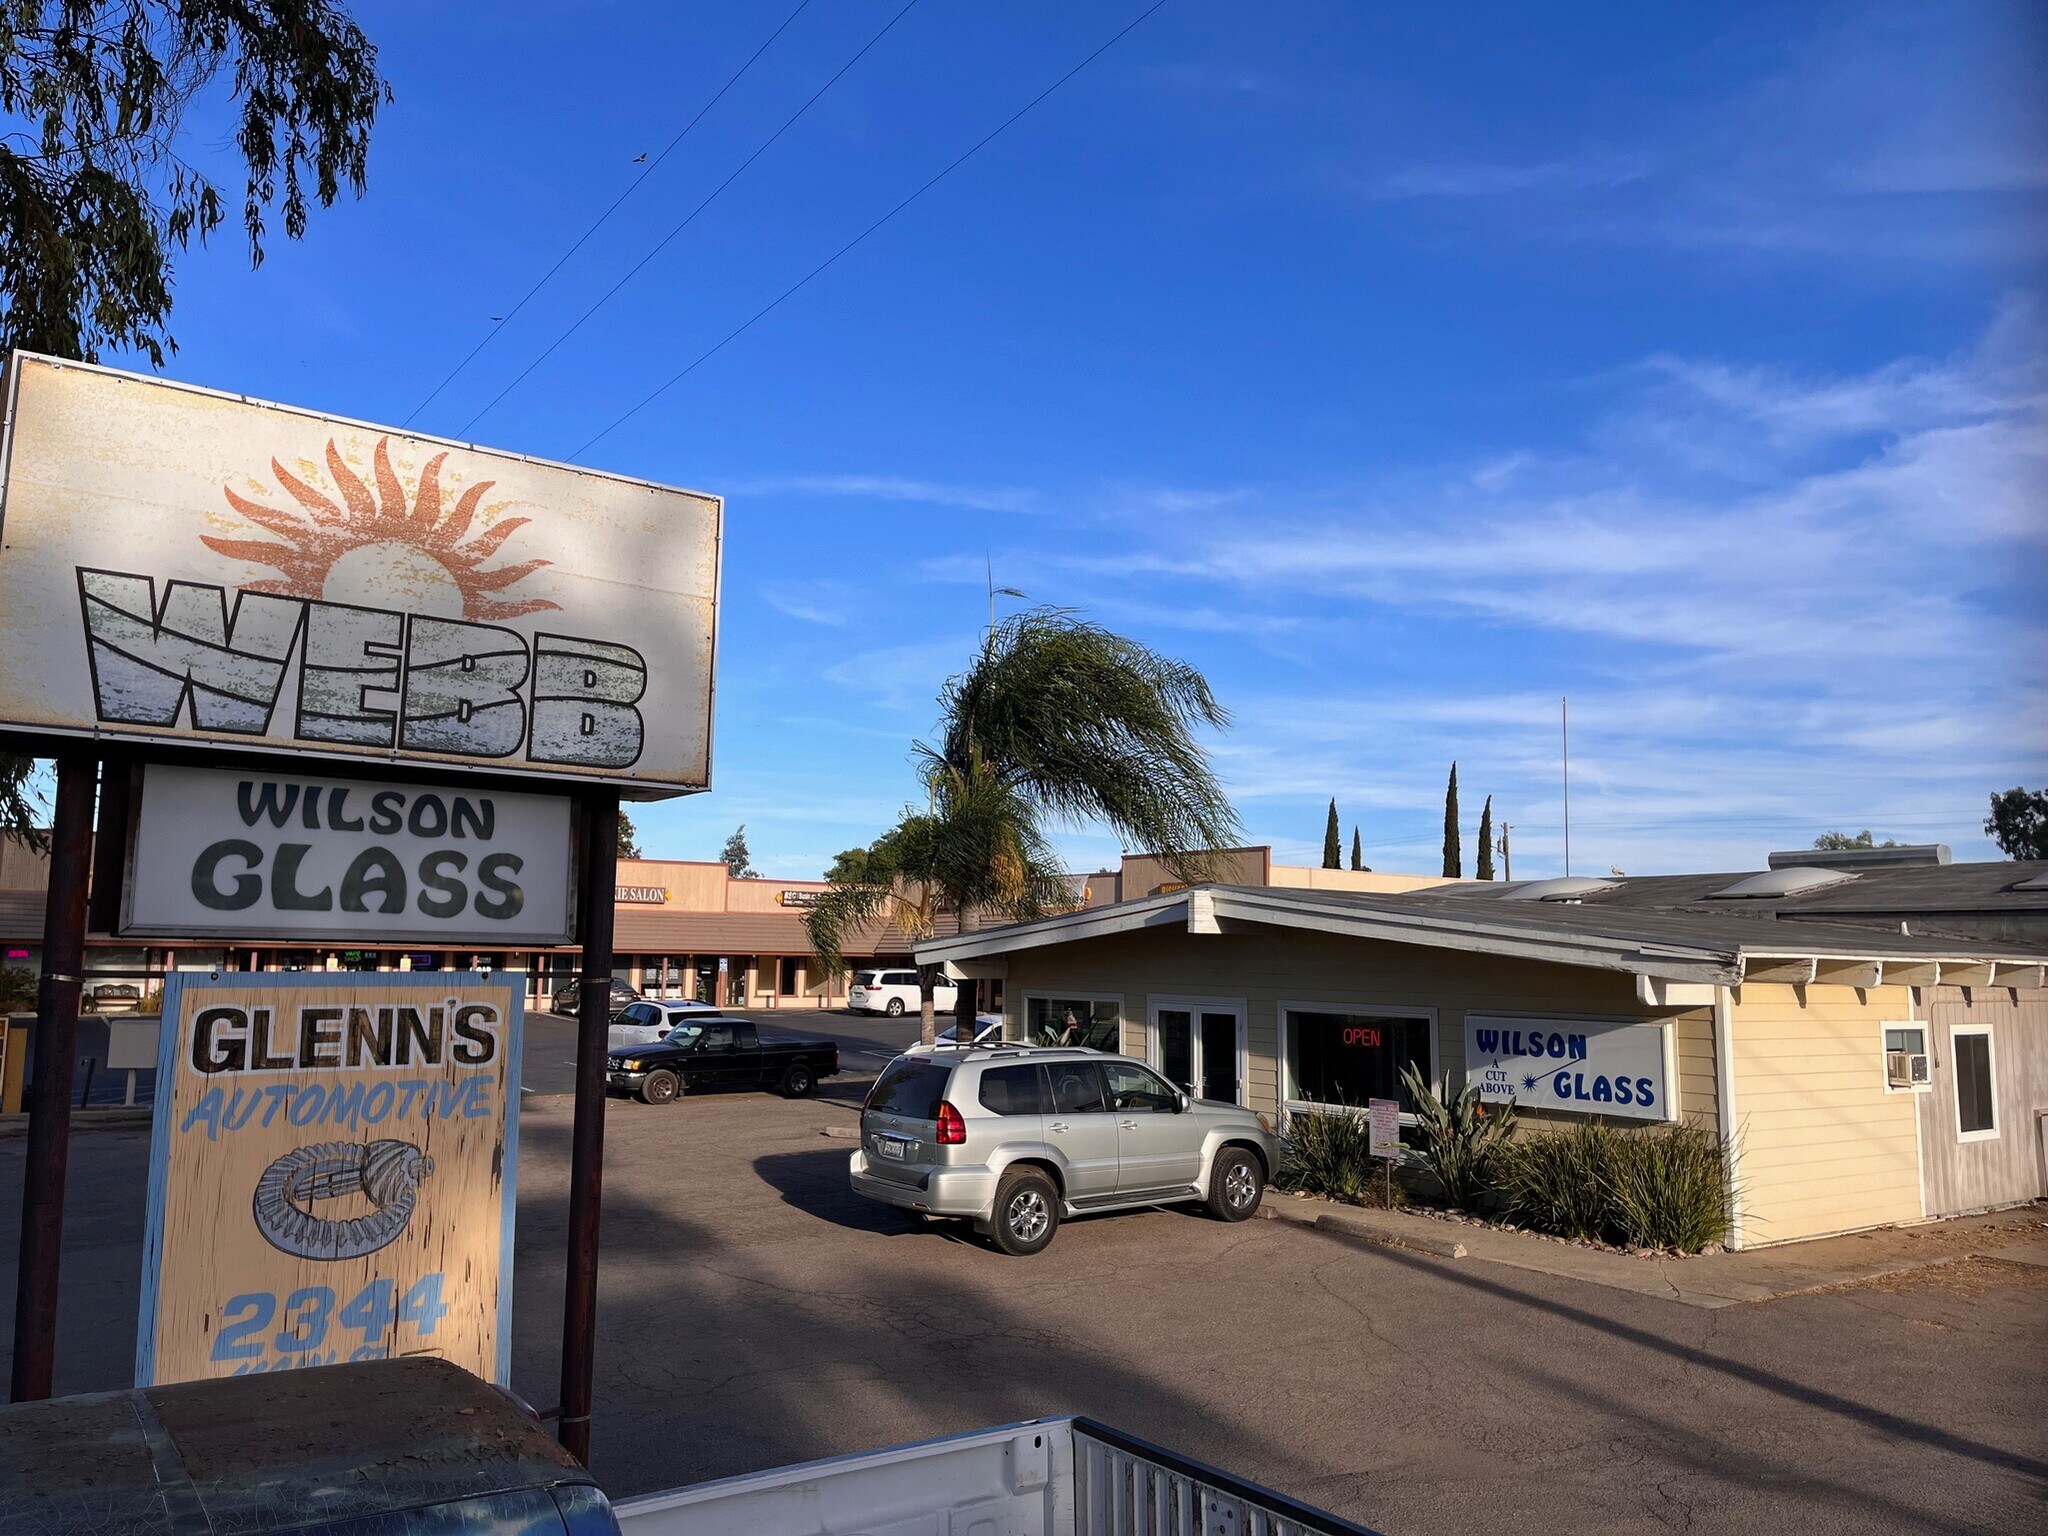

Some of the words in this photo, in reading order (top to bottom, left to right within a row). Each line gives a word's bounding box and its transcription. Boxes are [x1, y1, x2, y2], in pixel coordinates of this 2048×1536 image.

[76, 566, 647, 769] WEBB
[237, 780, 496, 841] WILSON
[191, 838, 525, 920] GLASS
[614, 886, 629, 900] IE
[630, 887, 665, 901] SALON
[1343, 1028, 1380, 1047] OPEN
[1476, 1029, 1587, 1060] WILSON
[1485, 1070, 1507, 1082] CUT
[1491, 1058, 1500, 1069] A
[1479, 1082, 1516, 1096] ABOVE
[1553, 1071, 1655, 1107] GLASS
[181, 1075, 495, 1141] AUTOMOTIVE
[210, 1272, 449, 1361] 2344
